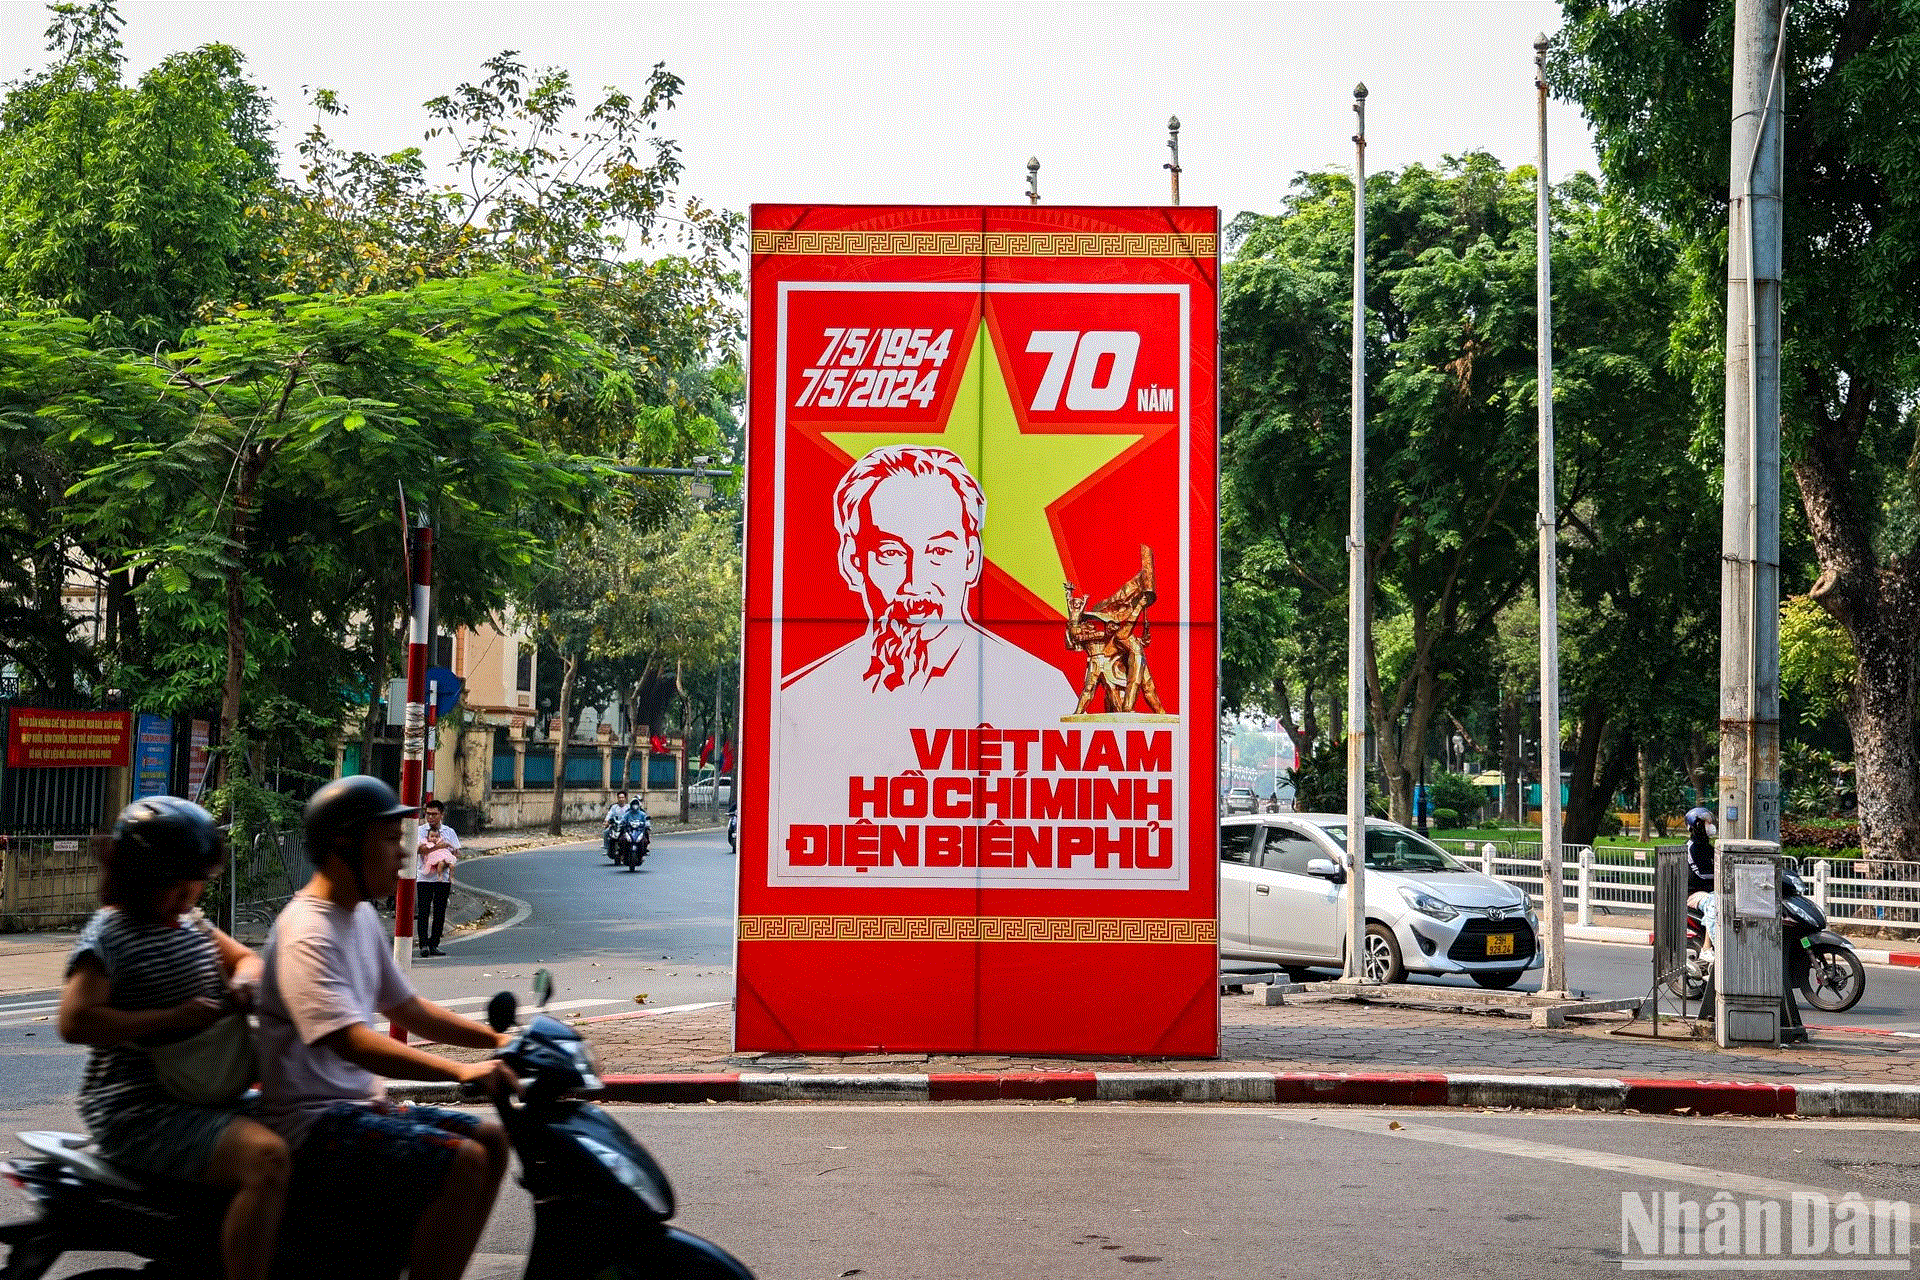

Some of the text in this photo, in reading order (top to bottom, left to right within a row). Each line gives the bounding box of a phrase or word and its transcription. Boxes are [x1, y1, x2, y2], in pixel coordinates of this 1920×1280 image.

[816, 328, 953, 367] 7/5/1954
[795, 368, 944, 408] 7/5/2024
[1025, 330, 1141, 411] 70
[1137, 385, 1173, 412] NĂM
[848, 769, 1173, 820] HỒ CHÍ MINH
[785, 818, 1173, 873] ĐIỆN BIÊN PHỦ
